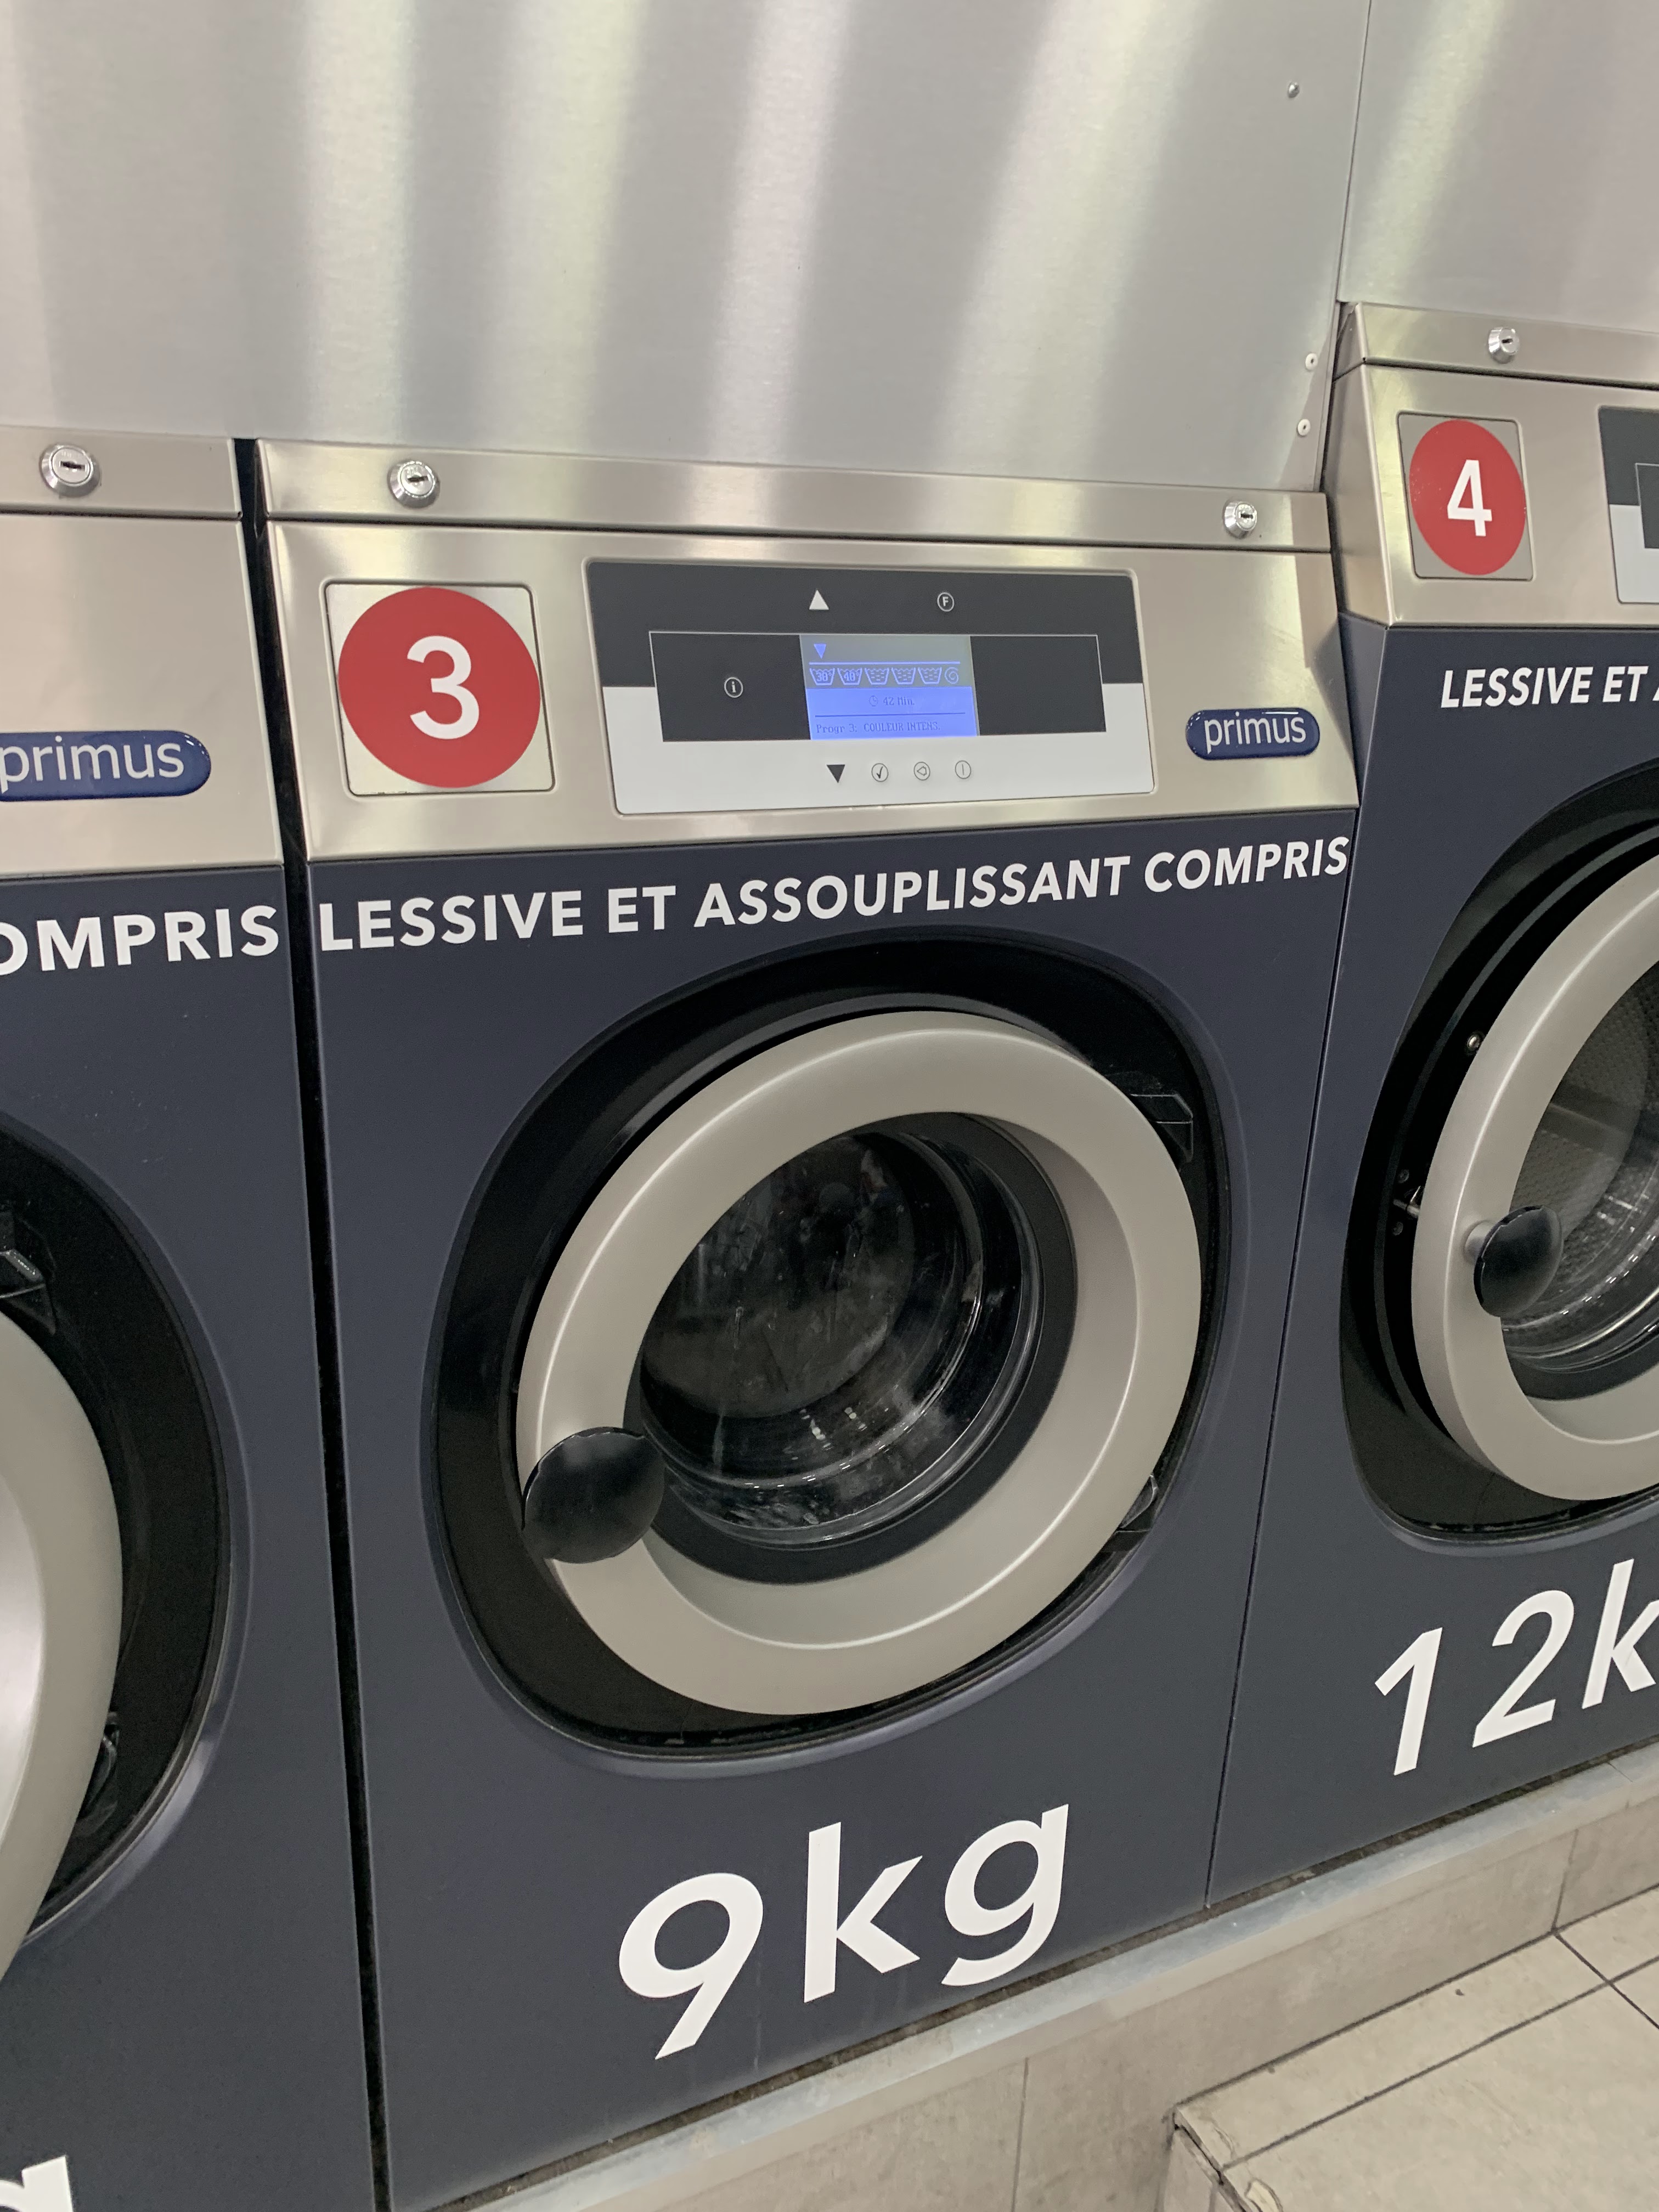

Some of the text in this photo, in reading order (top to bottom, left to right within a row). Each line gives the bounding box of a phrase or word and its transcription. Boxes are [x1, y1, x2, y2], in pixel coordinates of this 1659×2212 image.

[1446, 459, 1493, 537] 4
[407, 635, 479, 740] 3
[883, 696, 895, 706] 42
[1441, 667, 1594, 708] LESSIVE
[1602, 665, 1649, 703] ET
[864, 722, 904, 732] COULEUR
[1204, 711, 1306, 754] primus
[0, 735, 184, 794] primus
[319, 836, 1350, 951] LESSIVE ET ASSOUPLISSANT COMPRIS
[619, 1803, 1069, 2060] 9kg
